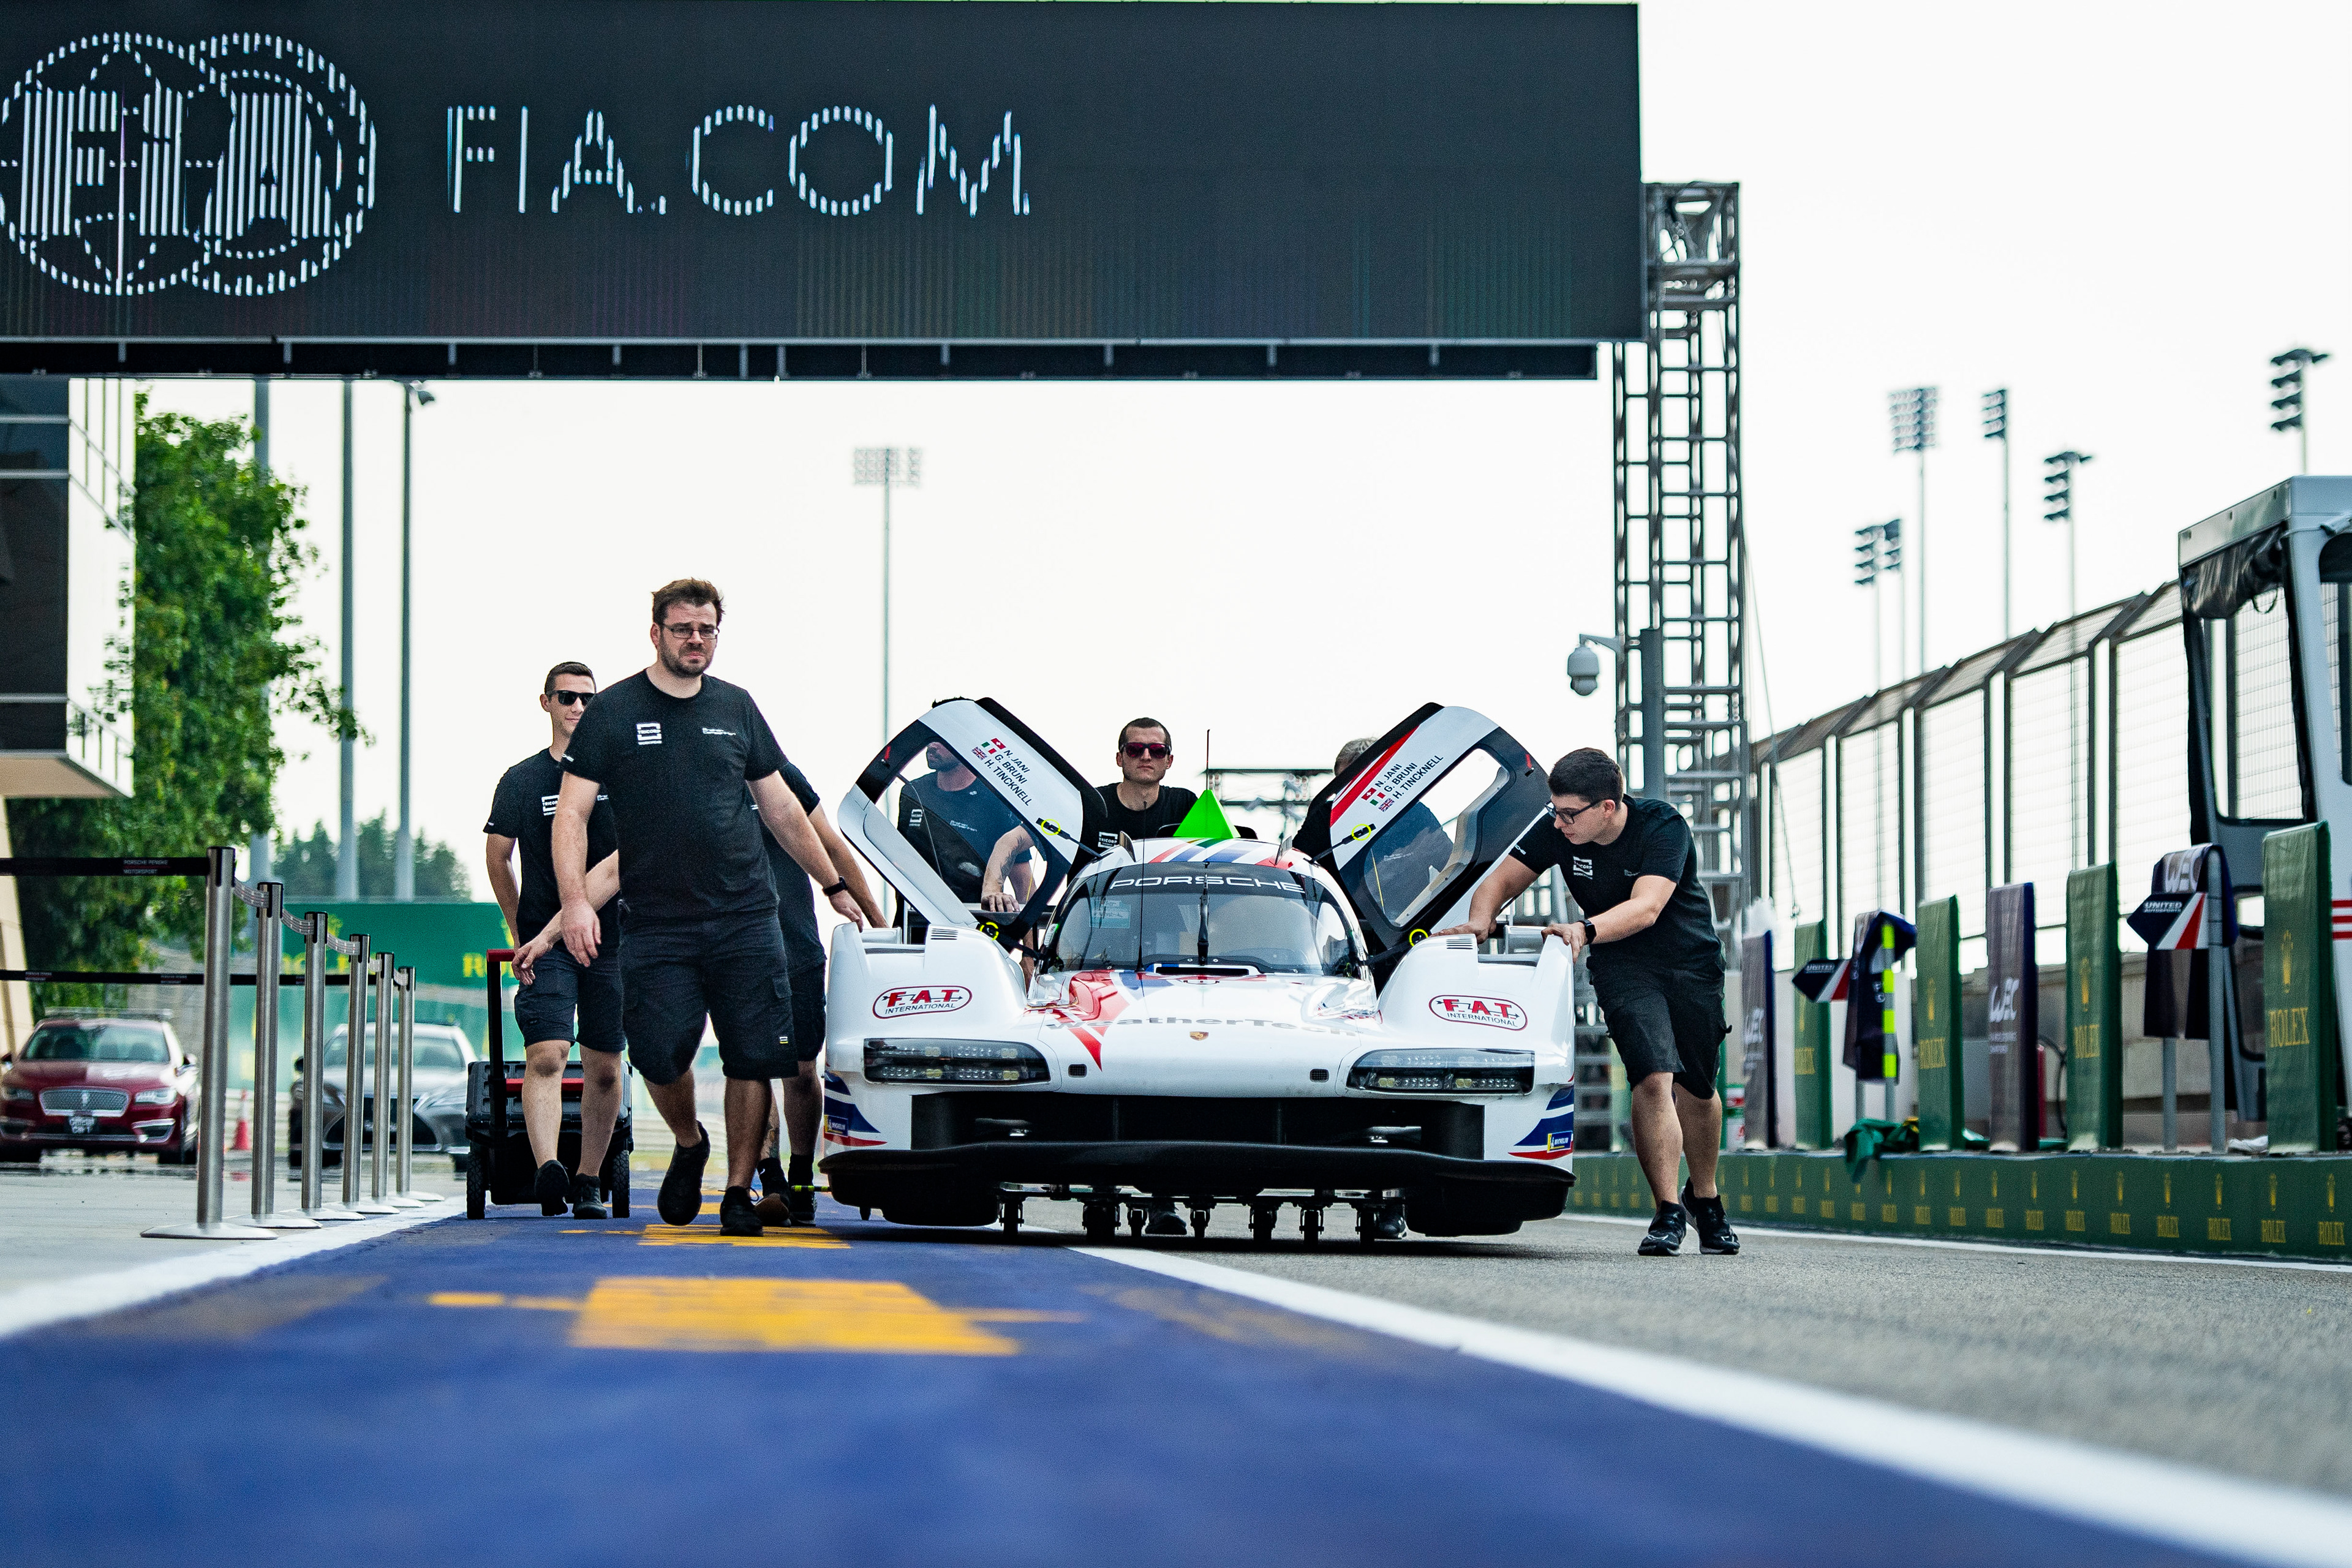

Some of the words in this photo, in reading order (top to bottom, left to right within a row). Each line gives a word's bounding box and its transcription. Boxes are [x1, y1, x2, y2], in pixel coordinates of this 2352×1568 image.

[995, 754, 1004, 763] G.
[1002, 761, 1028, 784] BRUNI
[1003, 750, 1013, 758] N.
[1011, 758, 1030, 773] JANI
[1384, 764, 1402, 780] JANI
[984, 759, 995, 769] H.
[993, 766, 1032, 806] TINCKNELL
[1392, 763, 1418, 785] BRUNI
[1392, 791, 1404, 799] H.
[1400, 755, 1444, 791] TINCKNELL
[1109, 876, 1306, 894] PORSCHE
[885, 1003, 956, 1014] INTERNATIONAL
[1447, 1012, 1518, 1027] INTERNATIONAL
[2269, 1007, 2310, 1048] ROLEX
